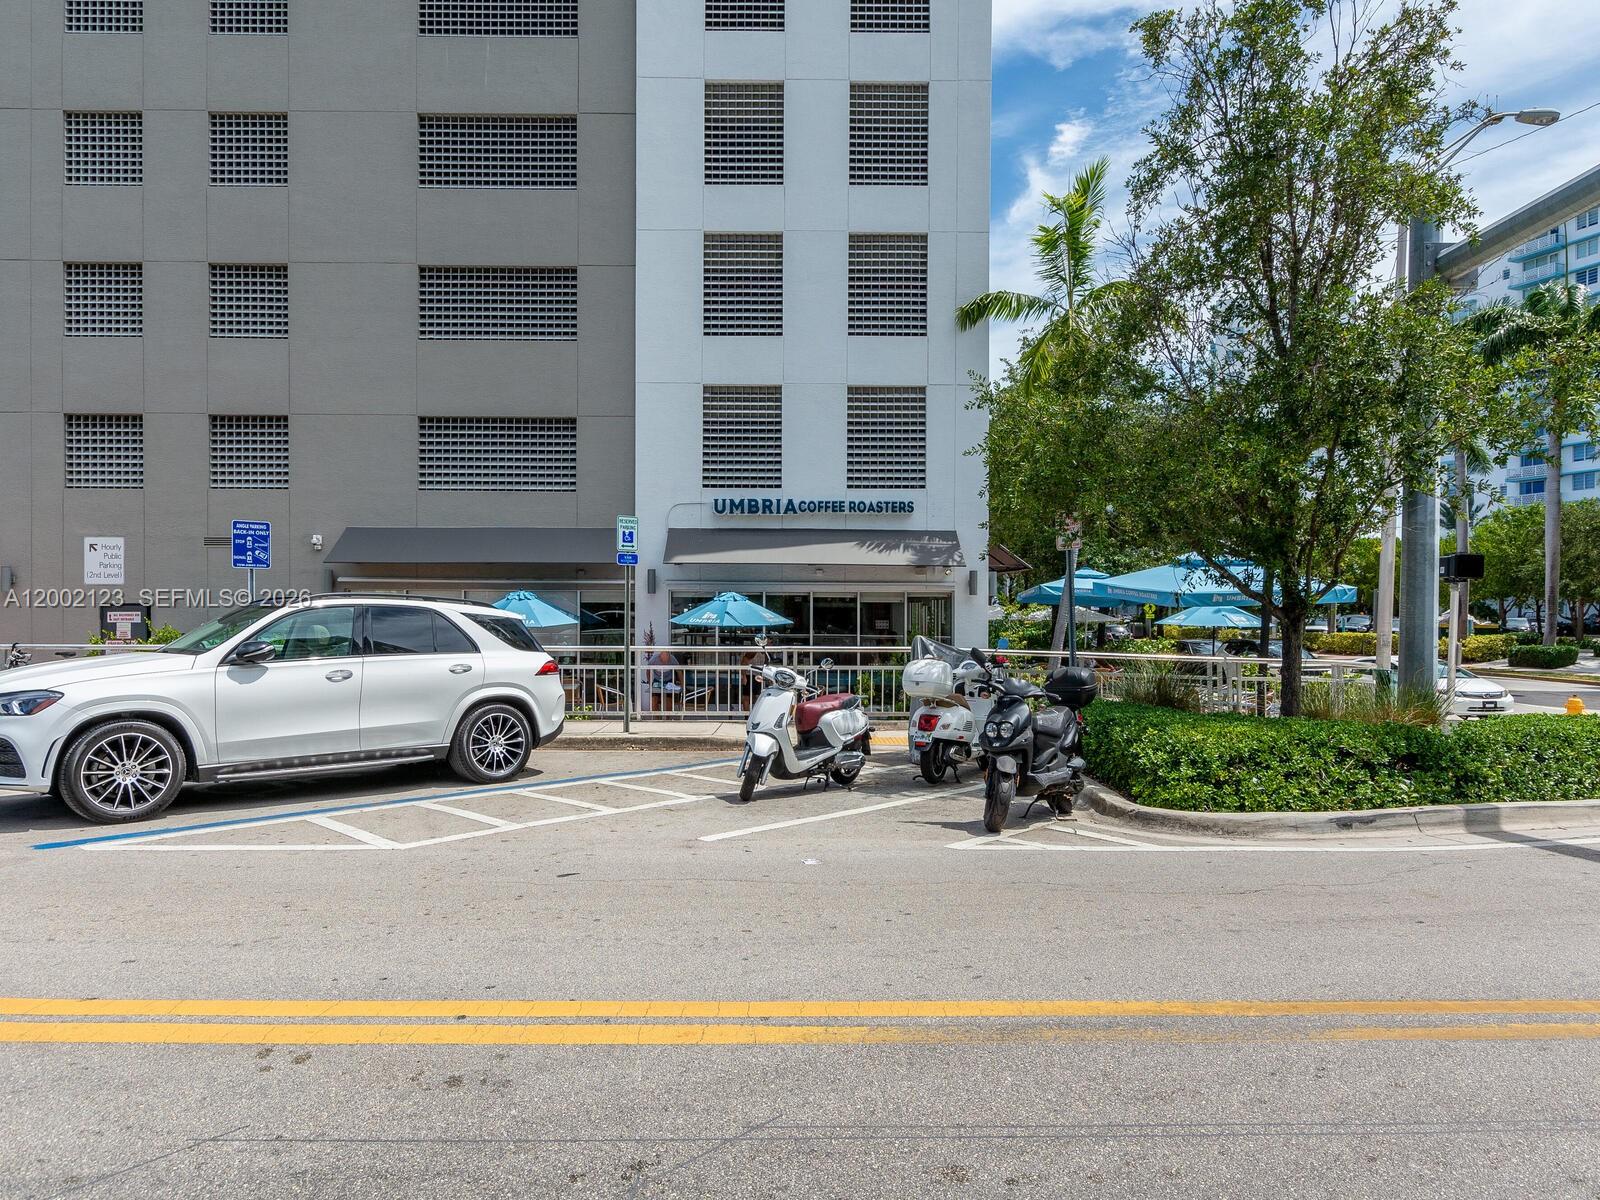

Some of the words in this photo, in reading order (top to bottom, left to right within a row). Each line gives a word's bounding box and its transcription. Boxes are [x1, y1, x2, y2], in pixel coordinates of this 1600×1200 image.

[713, 498, 798, 514] UMBRIA
[798, 500, 846, 513] COFFEE
[849, 500, 914, 513] ROASTERS
[101, 543, 121, 551] Hourly
[103, 552, 122, 560] Public
[99, 561, 122, 571] Parking
[87, 571, 102, 579] (2nd
[103, 571, 123, 579] Level)
